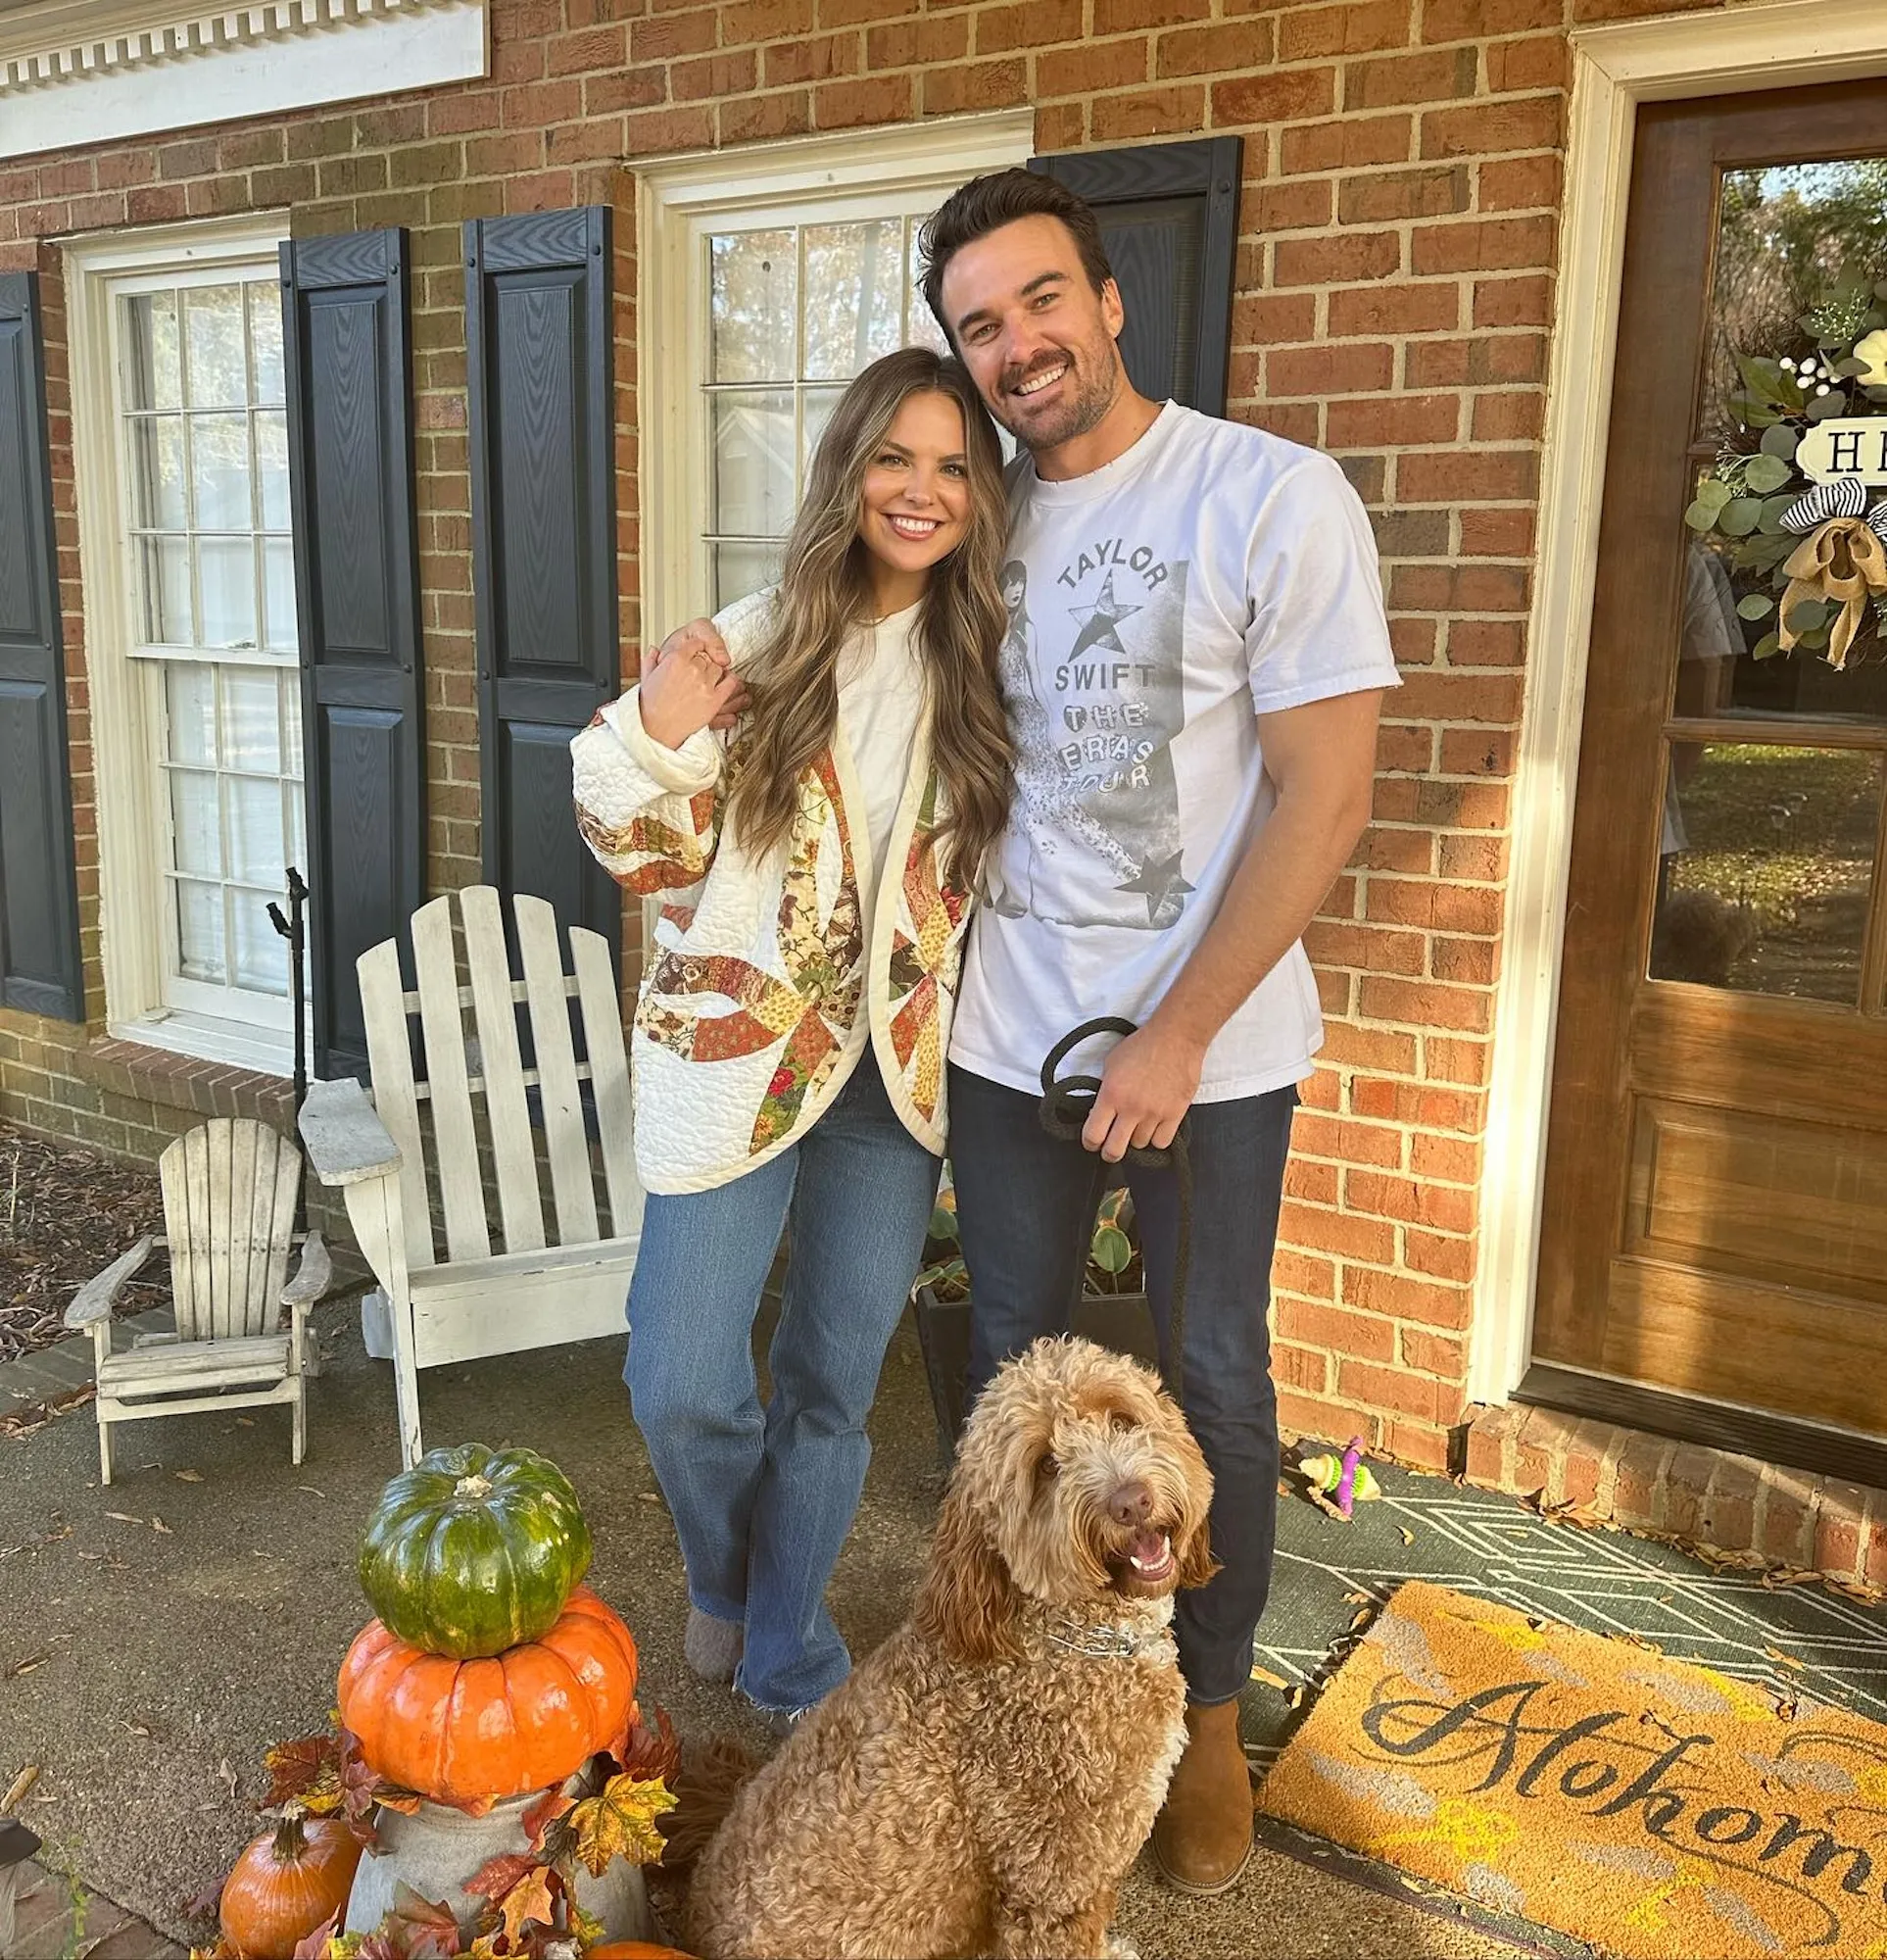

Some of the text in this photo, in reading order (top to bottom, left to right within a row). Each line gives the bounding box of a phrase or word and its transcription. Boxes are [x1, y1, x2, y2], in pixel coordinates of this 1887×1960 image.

[1056, 538, 1169, 592] TAYLOR
[1054, 662, 1156, 692] SWIFT
[1064, 703, 1145, 733] THE
[1059, 733, 1154, 771] ERAS
[1059, 763, 1151, 794] TOUR
[1358, 1679, 1887, 1906] Alohom
